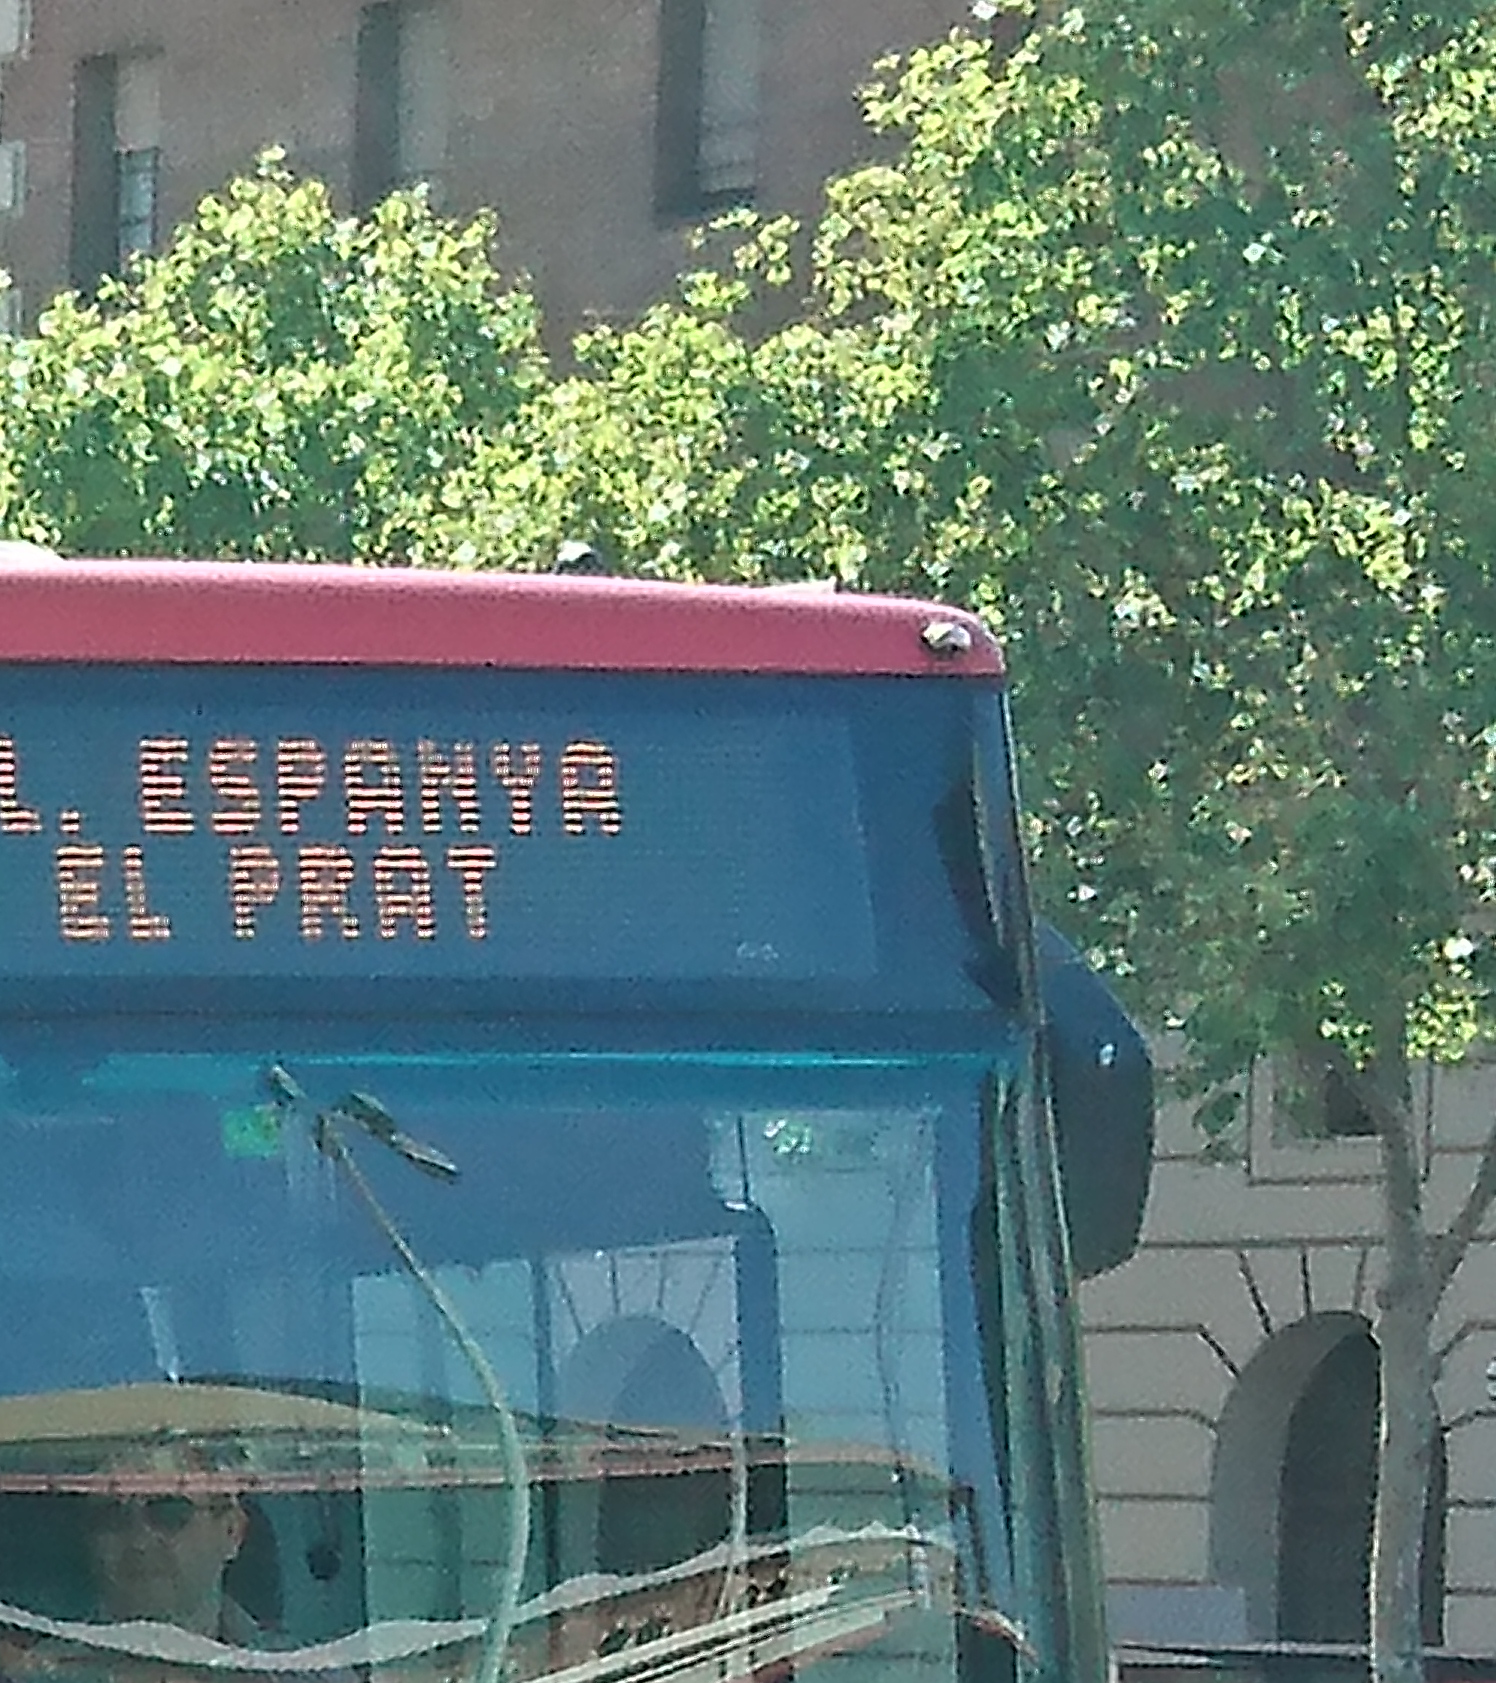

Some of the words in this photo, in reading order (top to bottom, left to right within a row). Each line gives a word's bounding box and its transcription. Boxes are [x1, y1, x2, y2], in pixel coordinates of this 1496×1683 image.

[138, 736, 624, 836] ESPANYA
[54, 844, 173, 941] EL
[228, 844, 499, 941] PRAT
